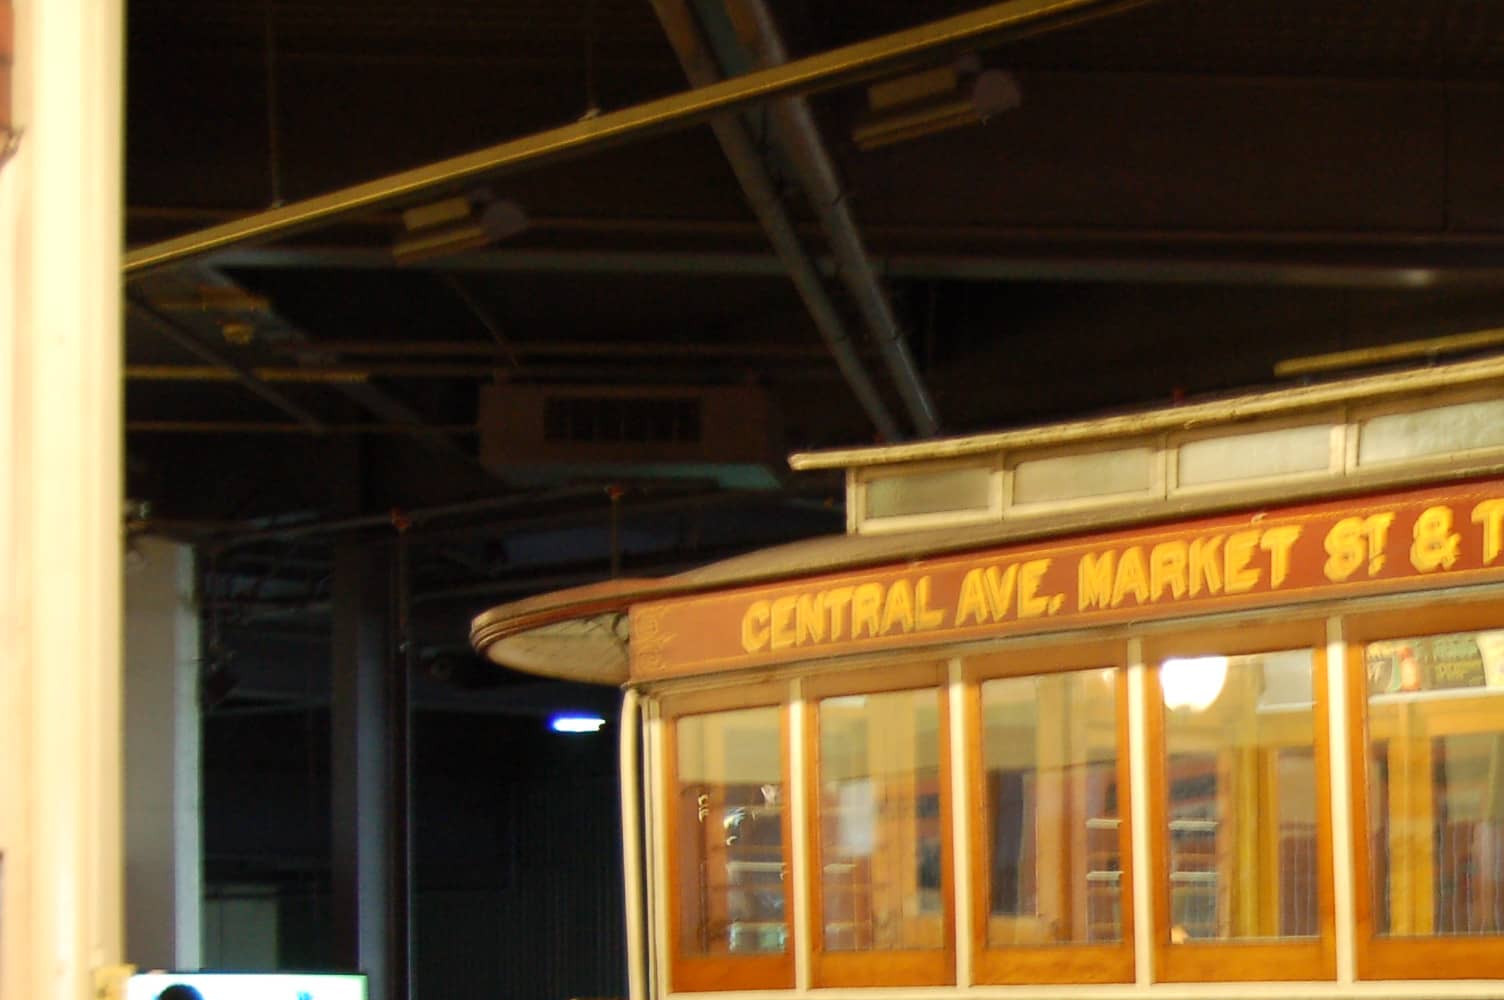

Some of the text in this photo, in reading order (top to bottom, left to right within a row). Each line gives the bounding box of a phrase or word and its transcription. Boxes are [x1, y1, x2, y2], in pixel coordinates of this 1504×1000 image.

[741, 576, 943, 653] CENTRAL
[1077, 525, 1302, 611] MARKET
[1410, 505, 1460, 573] &
